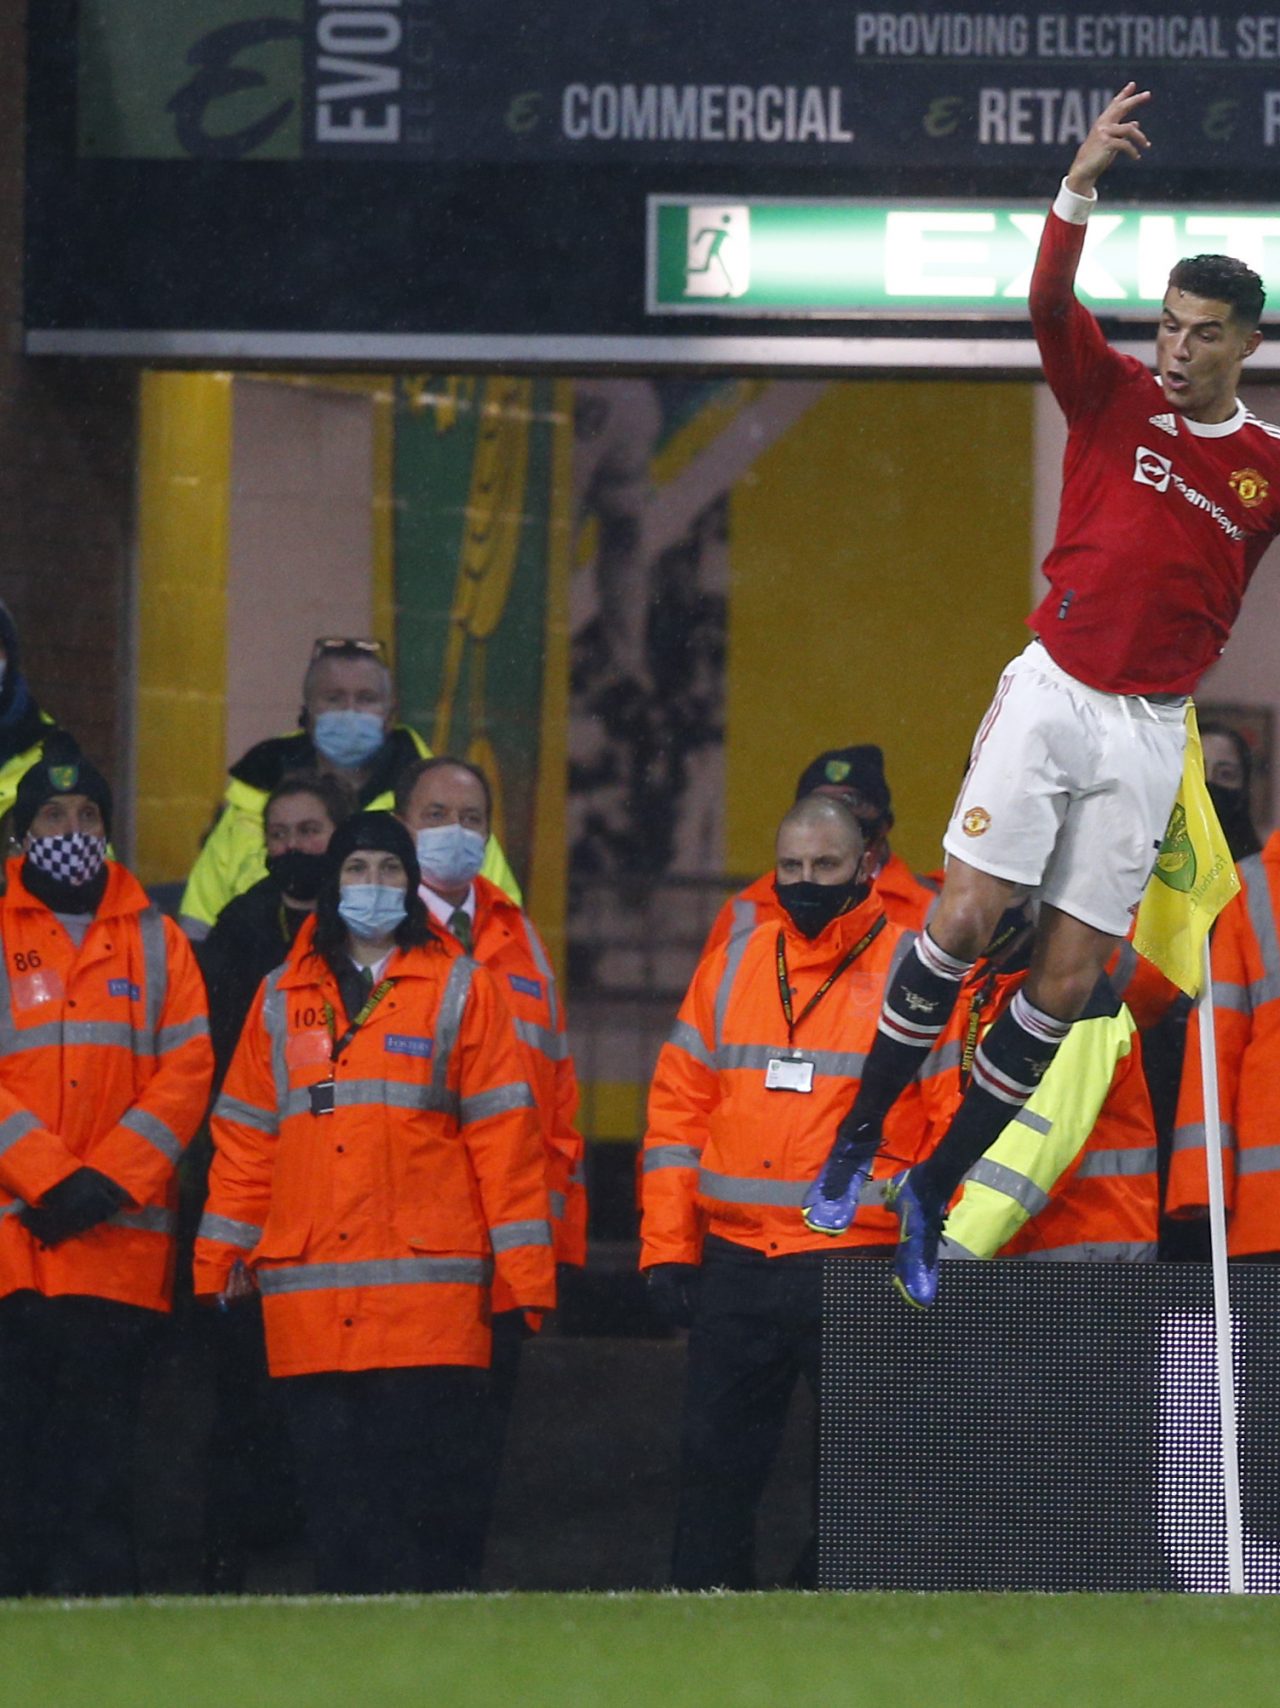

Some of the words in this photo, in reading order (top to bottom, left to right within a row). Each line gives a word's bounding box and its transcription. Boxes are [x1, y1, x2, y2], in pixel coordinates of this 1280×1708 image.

[856, 13, 1028, 56] PROVIDING
[1037, 14, 1228, 58] ELECTRICAL
[316, 0, 401, 142] EVO
[562, 83, 855, 143] COMMERCIAL
[978, 88, 1113, 145] RETAI
[1170, 473, 1246, 541] TeamView
[14, 949, 42, 972] 86
